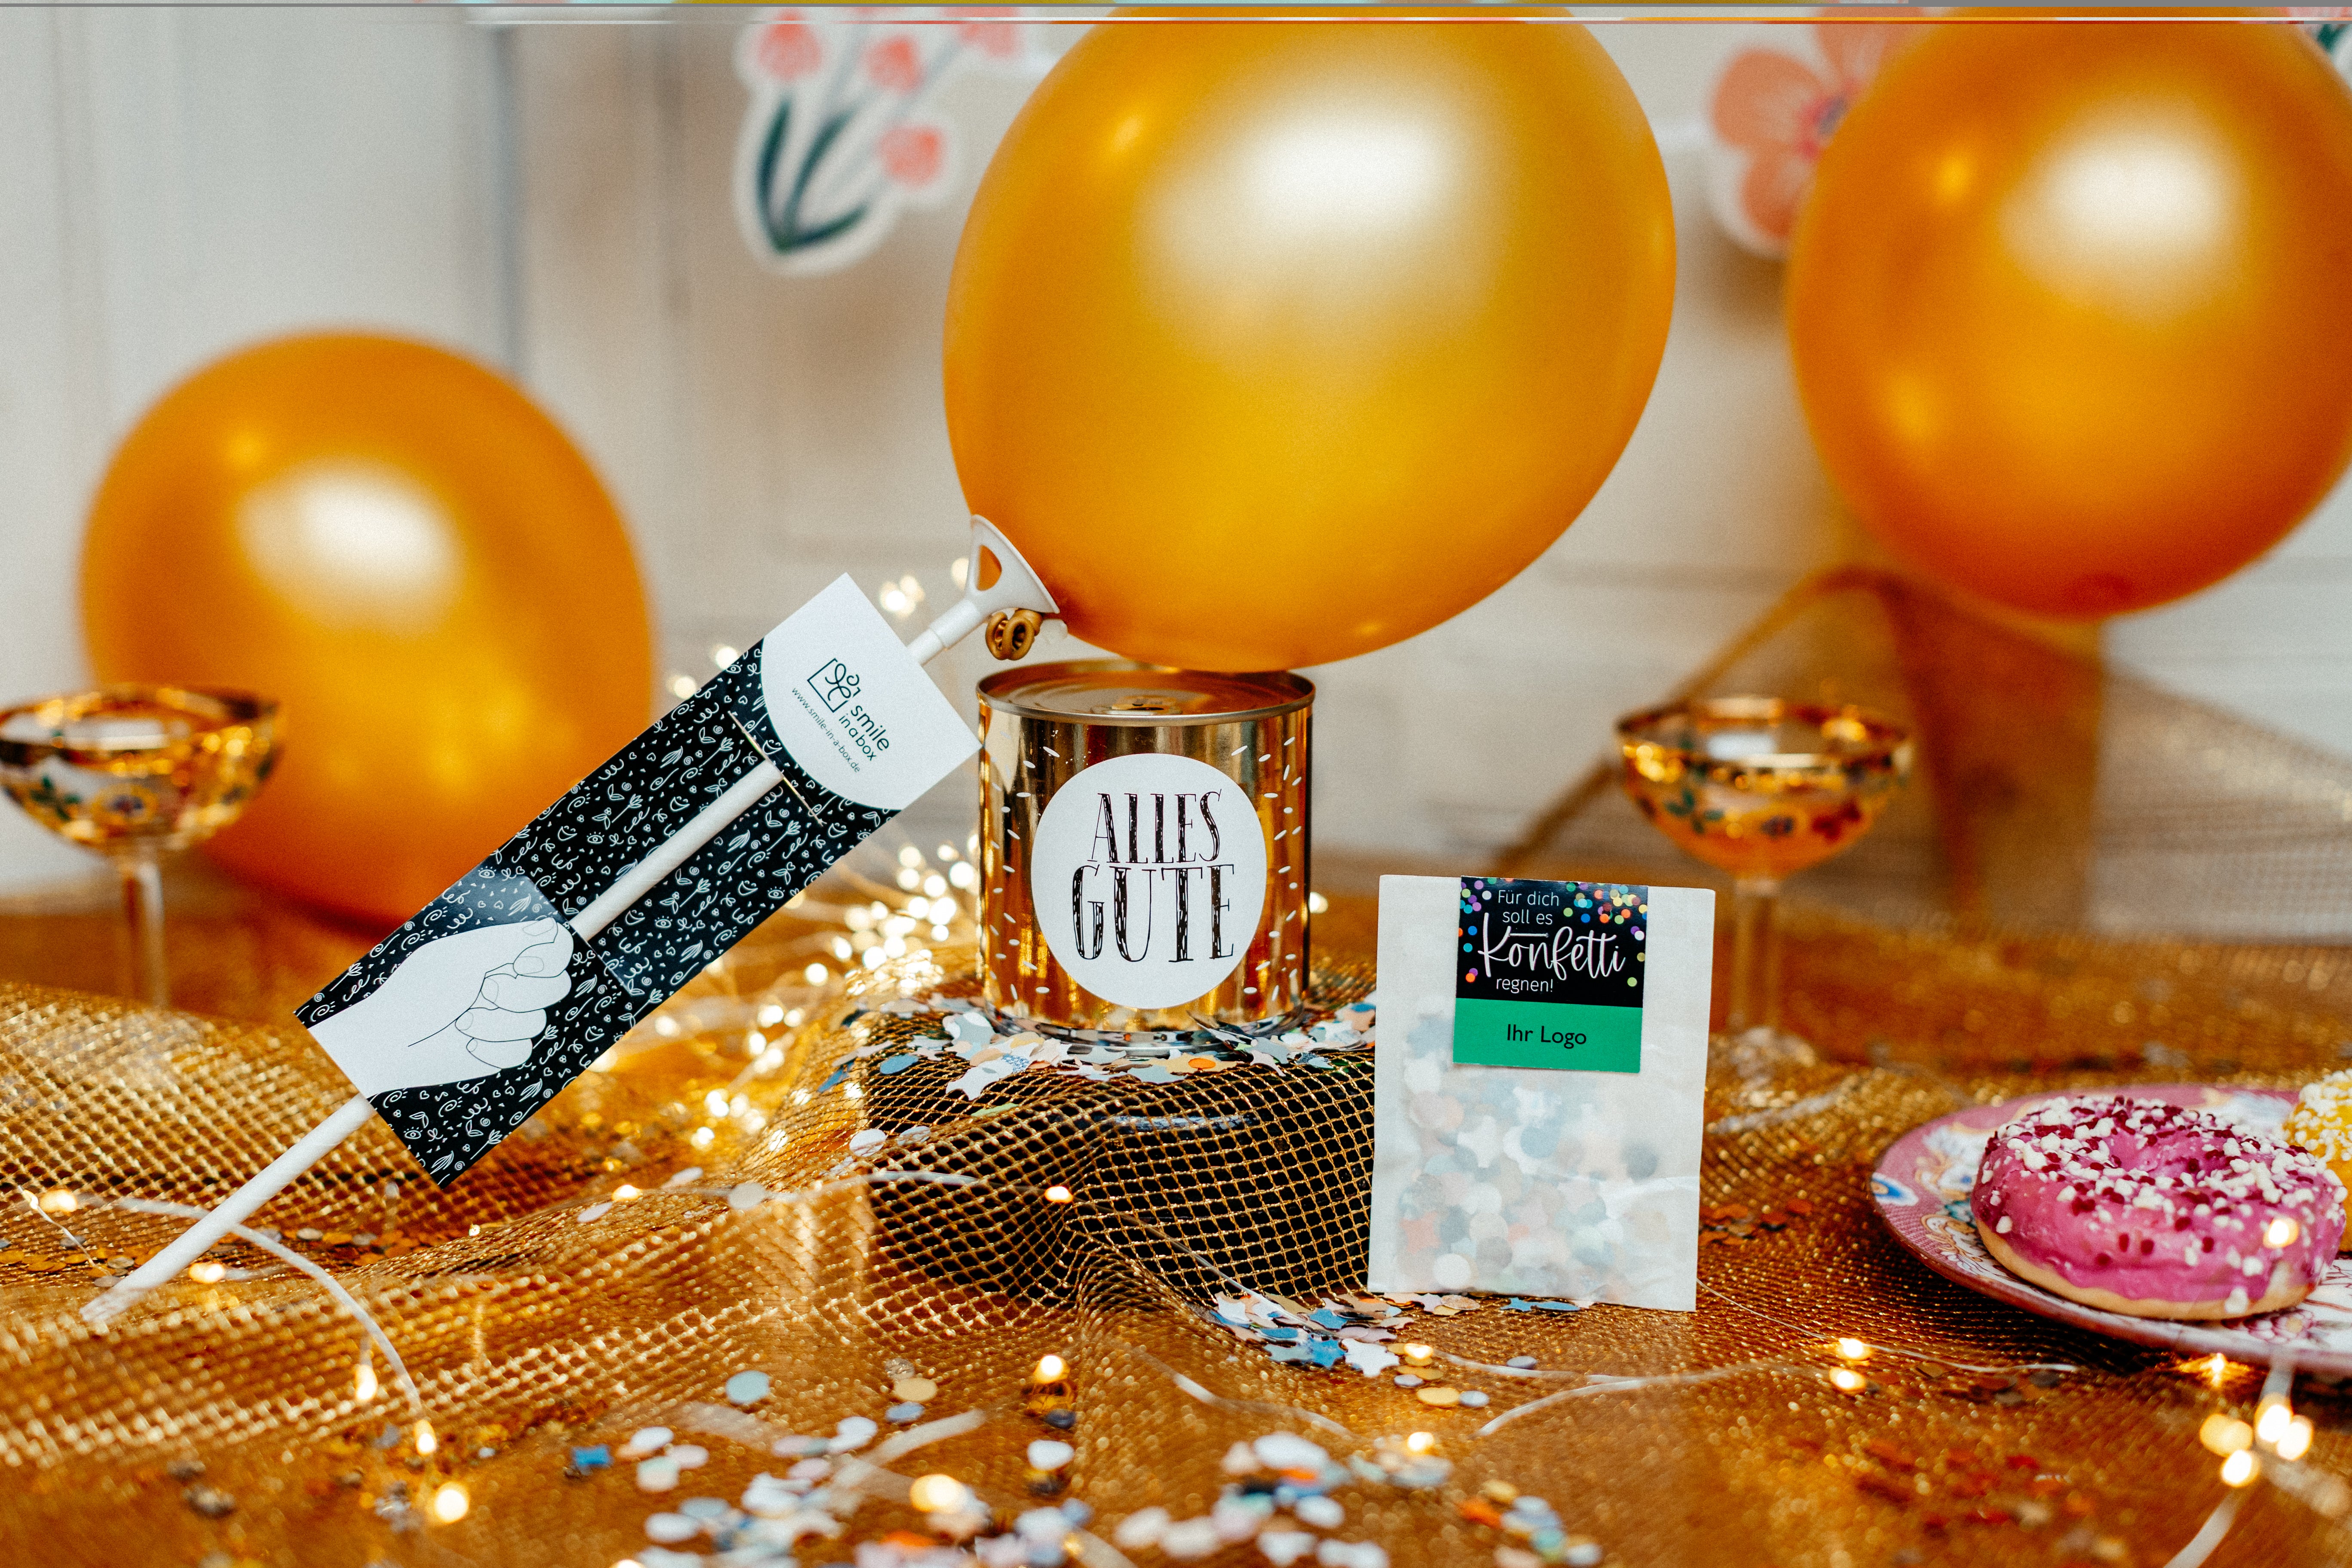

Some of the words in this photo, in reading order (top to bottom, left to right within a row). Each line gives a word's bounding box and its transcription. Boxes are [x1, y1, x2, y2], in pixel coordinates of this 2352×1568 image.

[792, 688, 860, 772] www.smile-in-a-box.de
[851, 705, 889, 751] smile
[1087, 789, 1222, 864] ALLES
[1072, 864, 1234, 962] GUTE
[1498, 890, 1522, 904] Für
[1527, 891, 1559, 906] dich
[1502, 909, 1530, 924] soll
[1536, 913, 1553, 925] es
[1477, 912, 1626, 981] Konfetti
[1496, 978, 1553, 993] regnen!
[1507, 1023, 1533, 1042] Ihr
[1540, 1025, 1587, 1049] Logo
